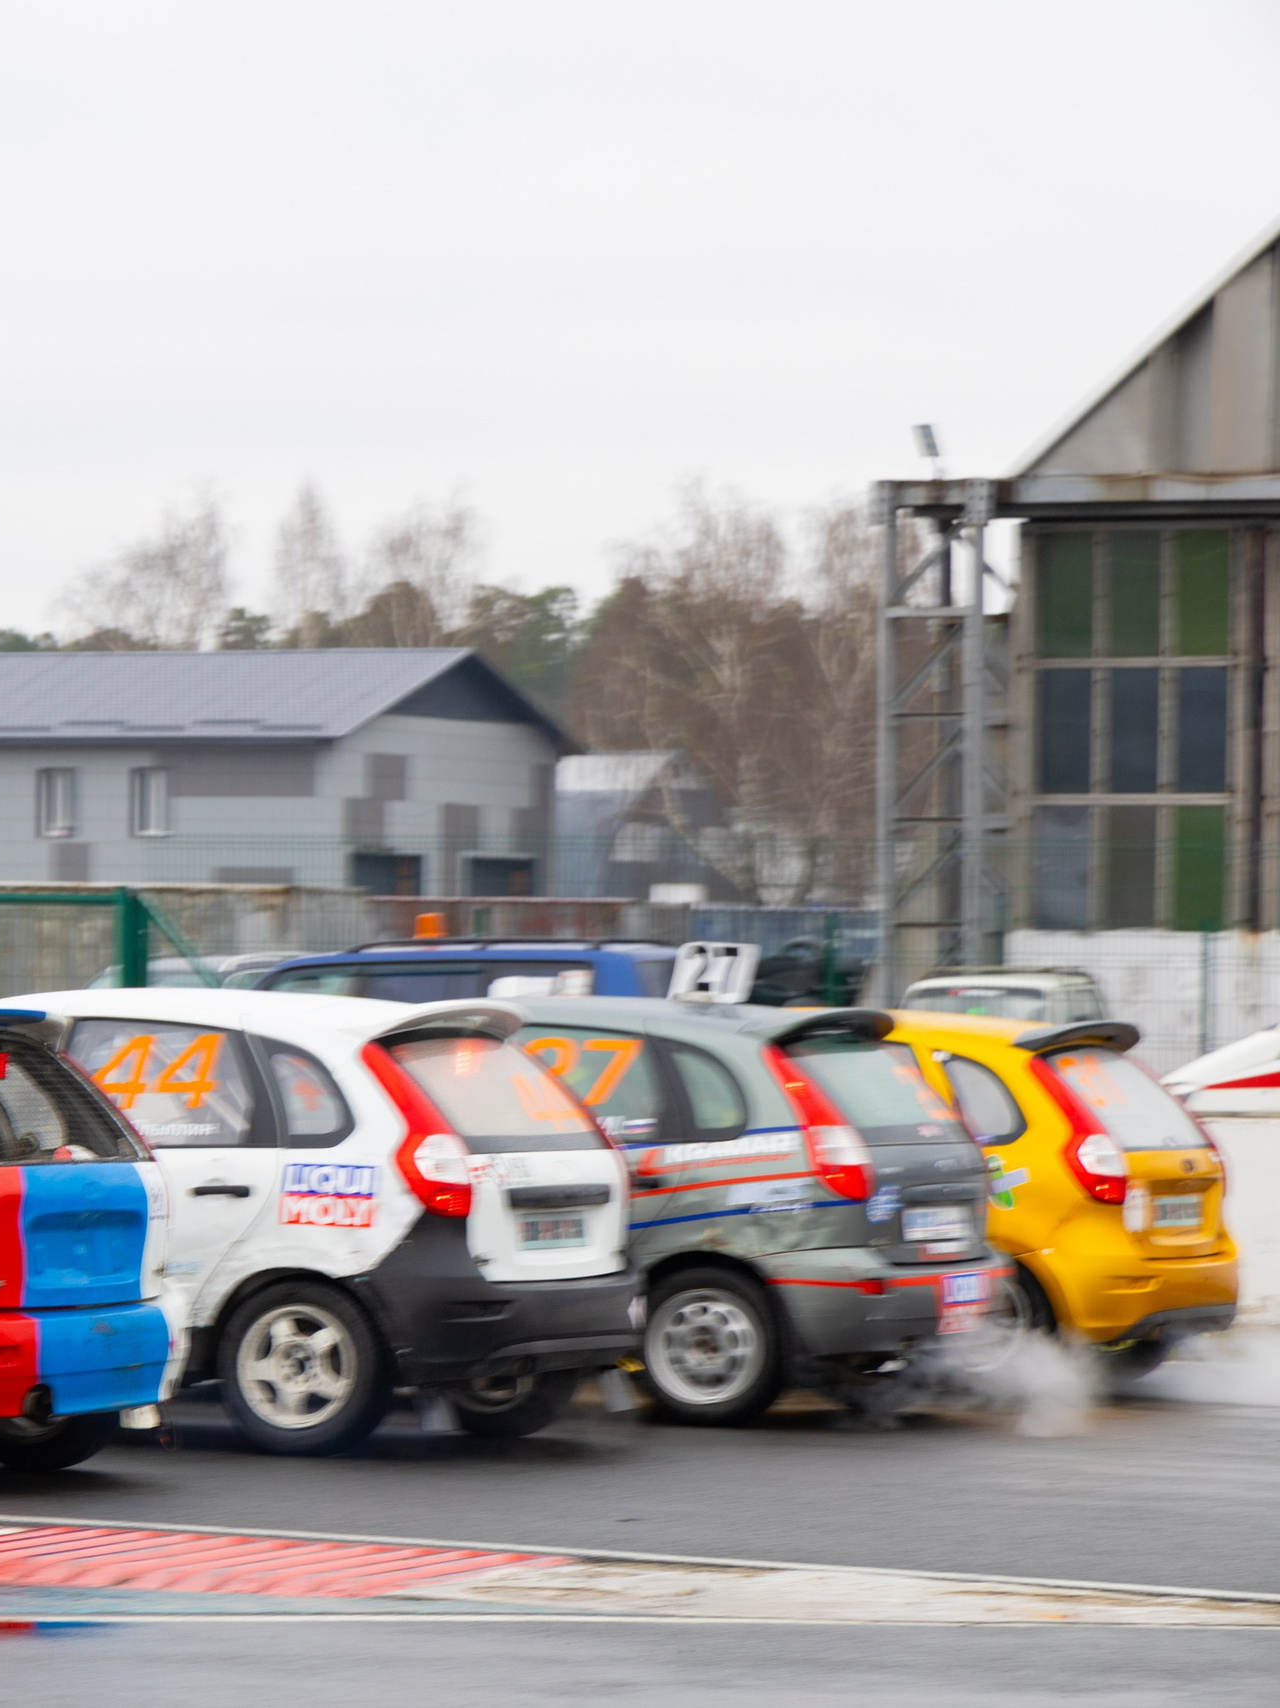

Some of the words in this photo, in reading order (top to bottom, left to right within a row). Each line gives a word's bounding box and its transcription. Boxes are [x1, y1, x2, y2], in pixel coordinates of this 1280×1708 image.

[684, 945, 740, 995] 27
[90, 1034, 226, 1109] 44
[283, 1165, 376, 1193] LIQUI
[280, 1195, 375, 1225] MOLY
